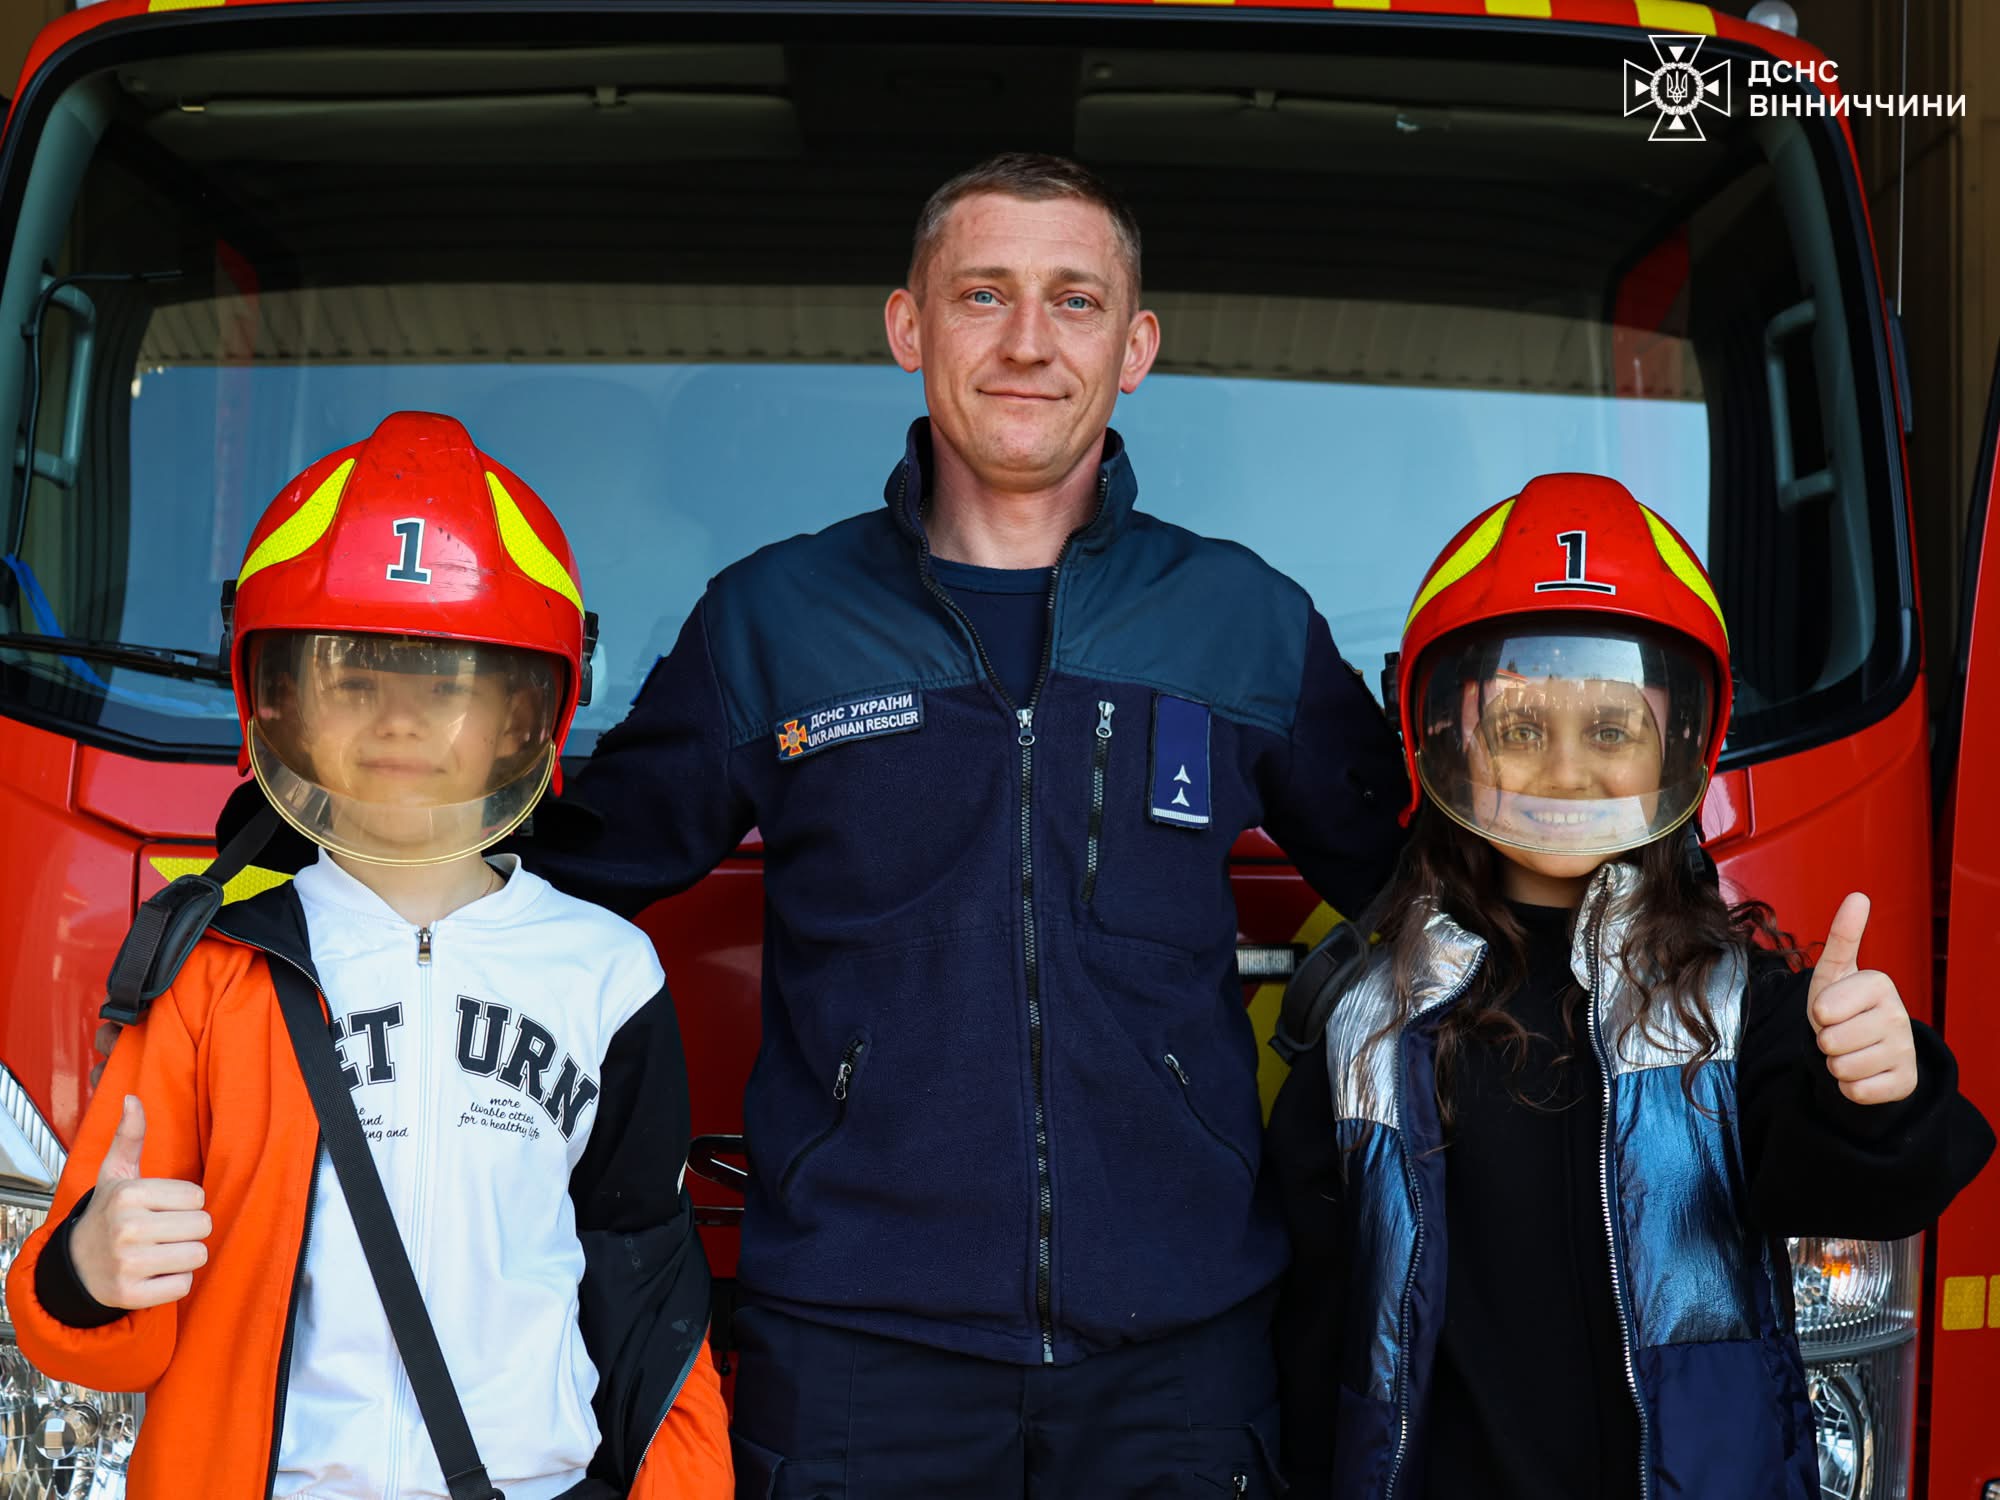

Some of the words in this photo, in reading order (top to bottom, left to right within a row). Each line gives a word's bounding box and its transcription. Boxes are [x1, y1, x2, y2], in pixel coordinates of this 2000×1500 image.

[386, 517, 432, 585] 1
[1534, 530, 1616, 596] 1
[807, 721, 865, 747] UKRAINIAN
[866, 711, 919, 730] RESCUER
[810, 707, 845, 730] ДСНС
[850, 694, 913, 717] УКРАЇНИ
[456, 995, 600, 1143] URN
[470, 1102, 506, 1118] livable
[508, 1111, 534, 1124] cities
[490, 1098, 520, 1108] more
[386, 1127, 409, 1138] and
[457, 1112, 478, 1127] for
[480, 1117, 488, 1126] a
[490, 1119, 527, 1138] healthy
[528, 1126, 540, 1141] life
